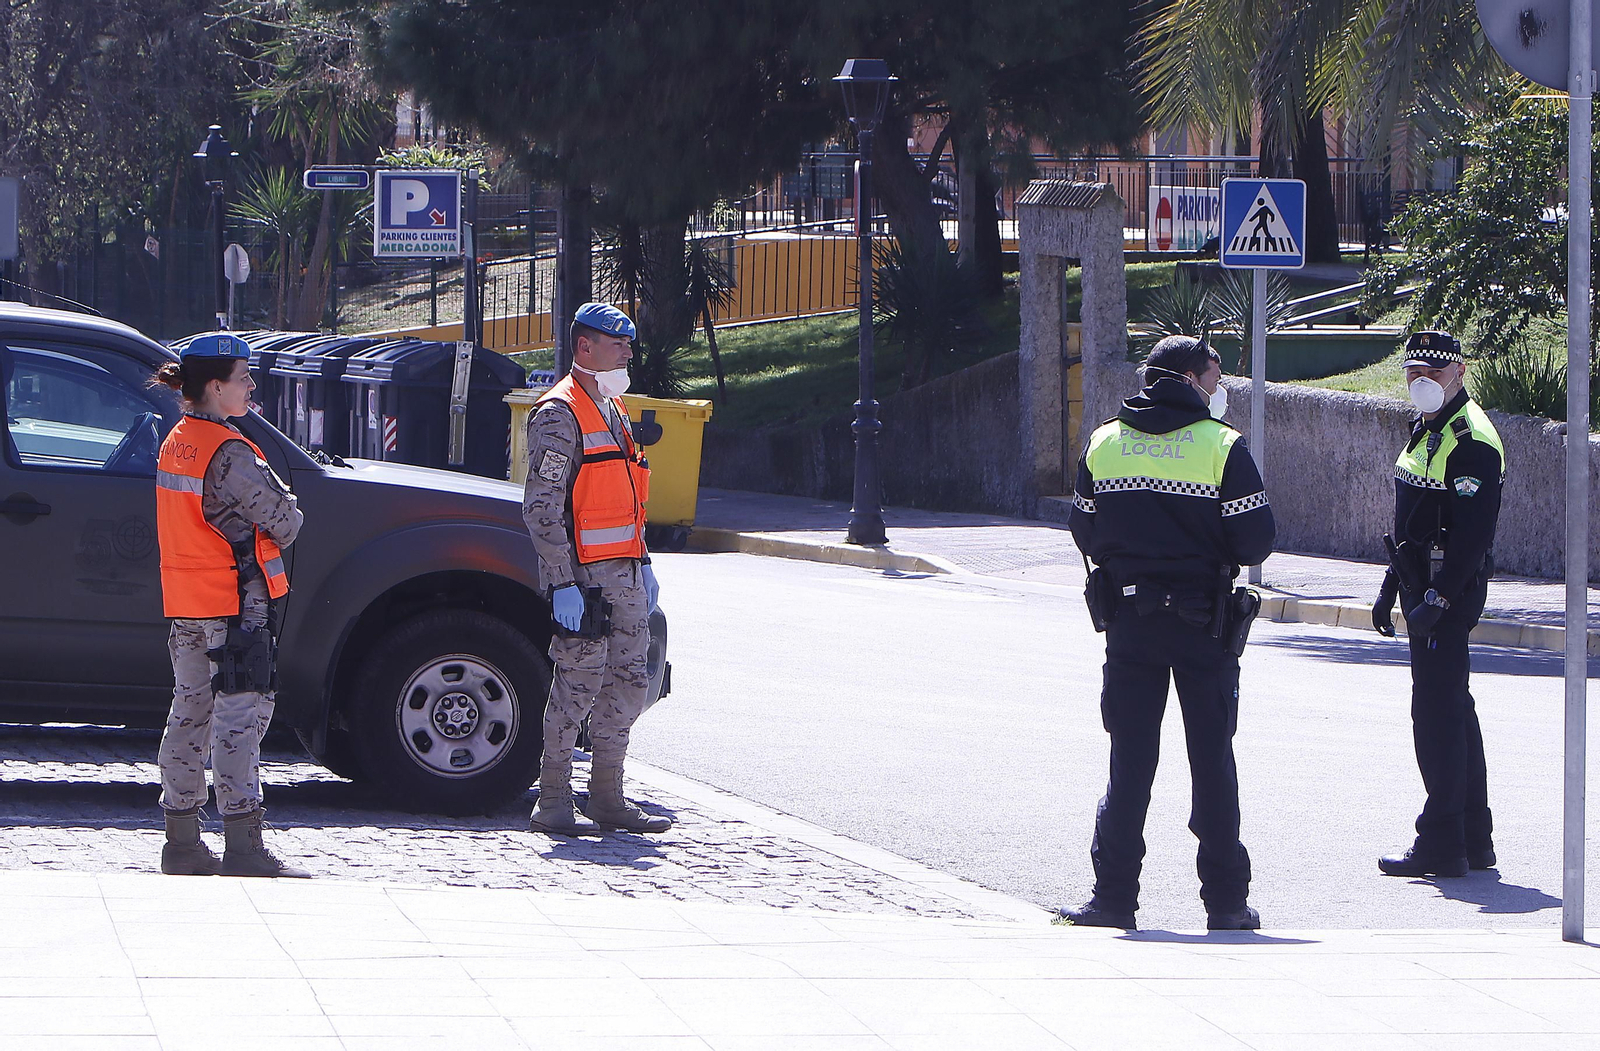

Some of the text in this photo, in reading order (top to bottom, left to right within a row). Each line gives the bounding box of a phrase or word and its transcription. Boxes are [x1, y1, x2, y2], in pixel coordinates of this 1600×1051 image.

[327, 175, 348, 183] LIBRE
[390, 179, 430, 226] P
[380, 232, 457, 241] PARKING CLIENTES
[380, 243, 456, 253] MERCADONA
[1121, 442, 1186, 460] LOCAL
